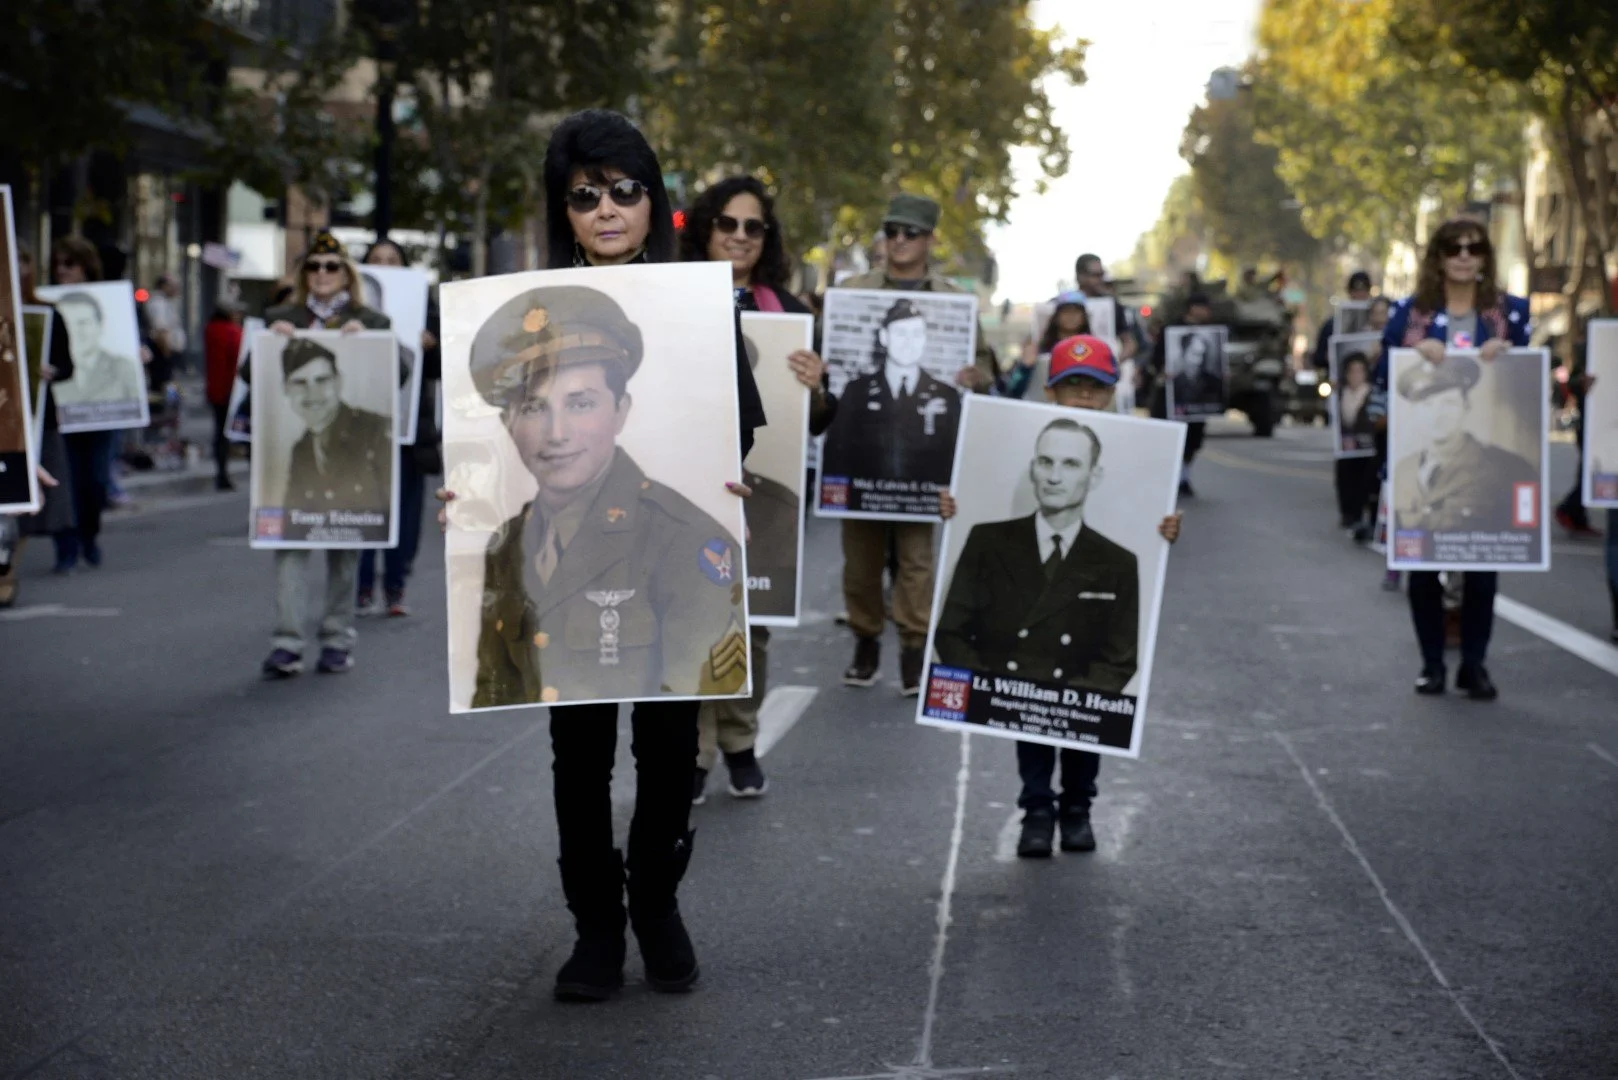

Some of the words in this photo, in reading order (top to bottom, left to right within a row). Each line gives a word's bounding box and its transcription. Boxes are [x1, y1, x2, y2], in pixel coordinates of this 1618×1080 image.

[973, 676, 991, 691] Lt.
[994, 677, 1060, 703] William
[1062, 688, 1082, 706] D.
[1085, 692, 1135, 715] Heath
[990, 696, 1028, 711] Hospital
